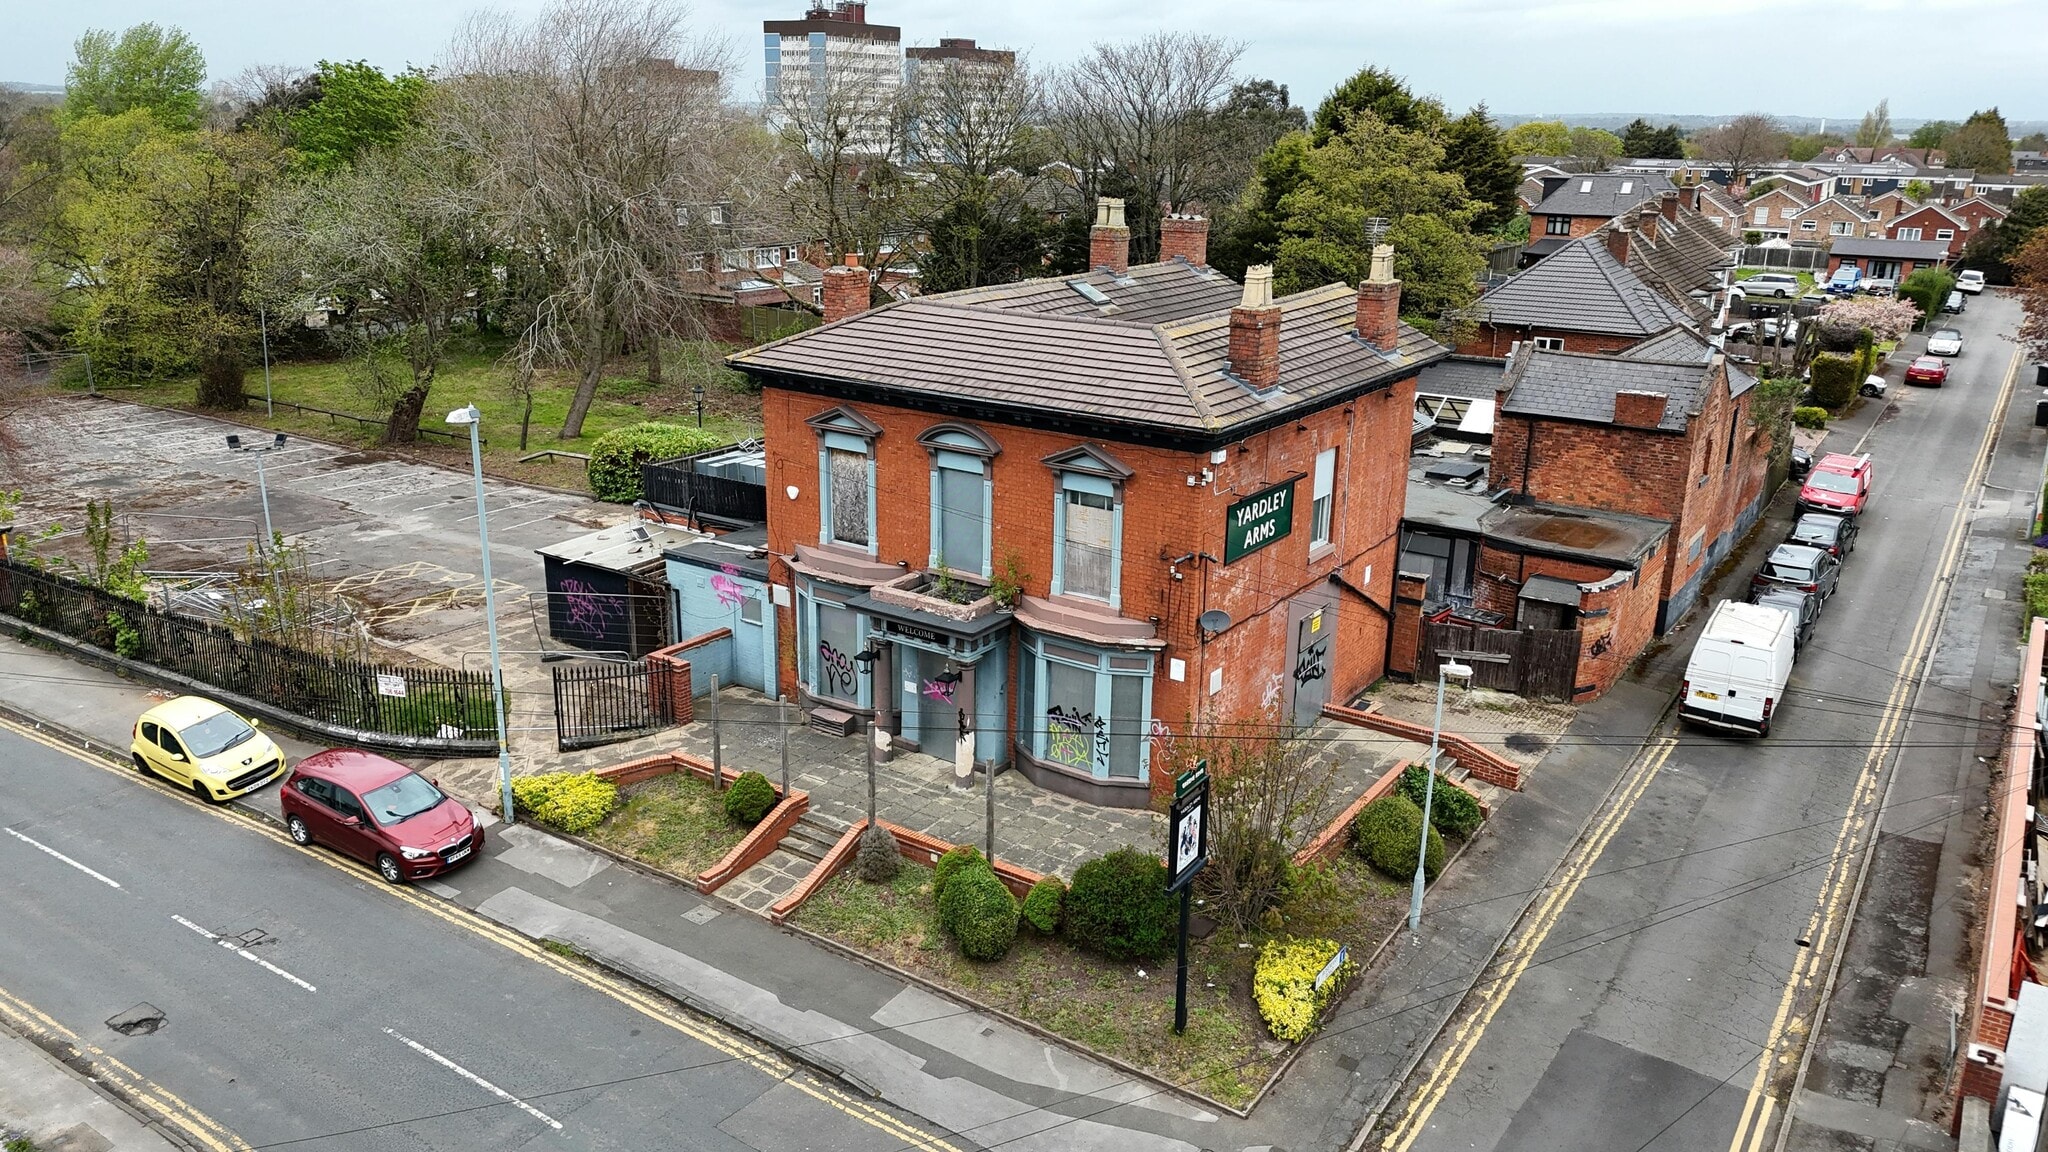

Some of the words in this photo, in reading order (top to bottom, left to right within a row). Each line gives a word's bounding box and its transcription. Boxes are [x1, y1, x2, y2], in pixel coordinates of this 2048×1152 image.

[1236, 489, 1287, 527] YARDLEY
[1243, 518, 1276, 549] ARMS
[897, 624, 936, 640] WELCOME
